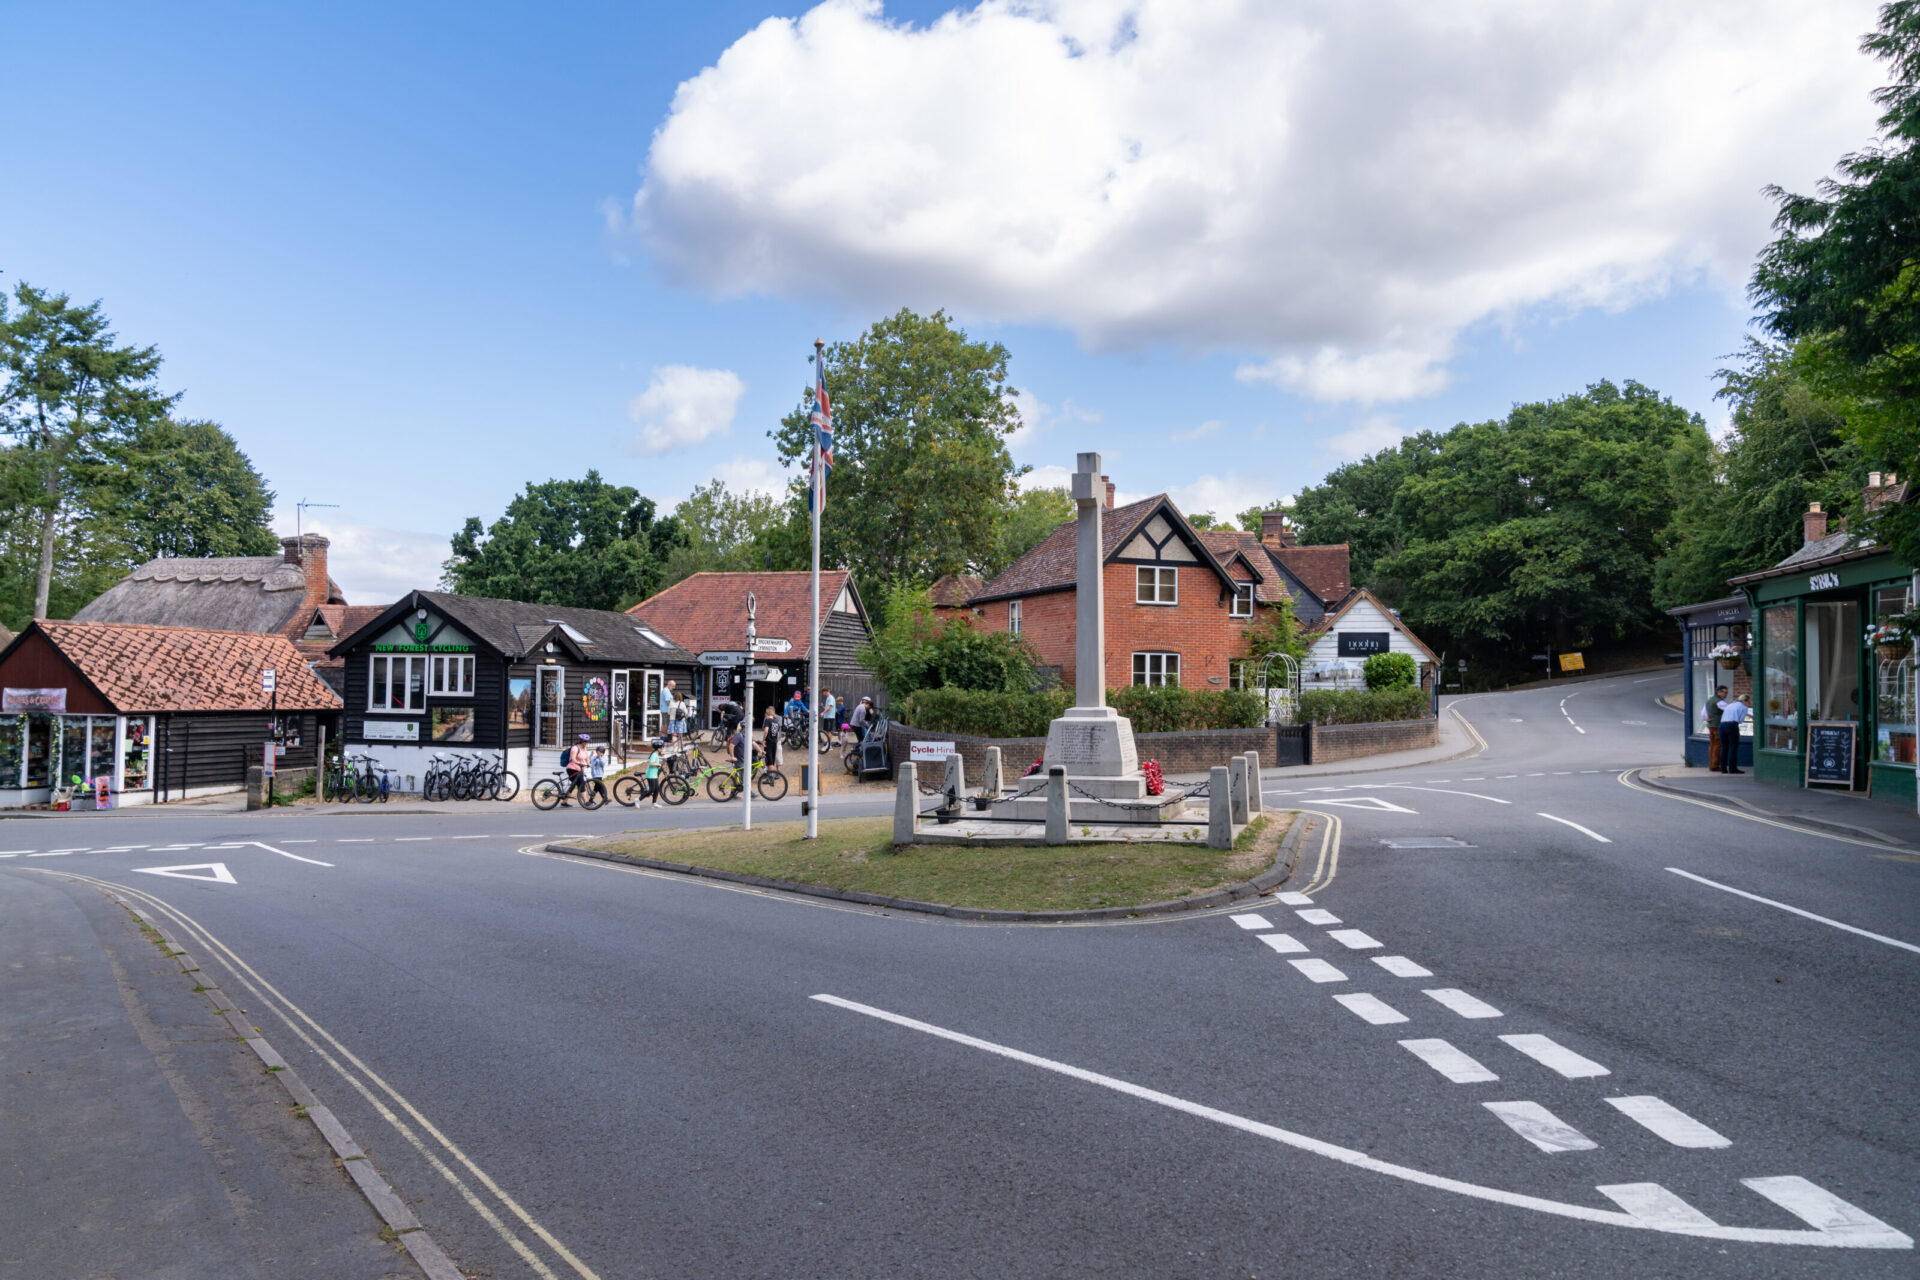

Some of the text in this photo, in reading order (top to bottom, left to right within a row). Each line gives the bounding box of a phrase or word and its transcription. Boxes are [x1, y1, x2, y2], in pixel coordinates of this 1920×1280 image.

[375, 643, 469, 652] NEW FOREST CYCLING
[911, 745, 956, 755] Cycle Hire
